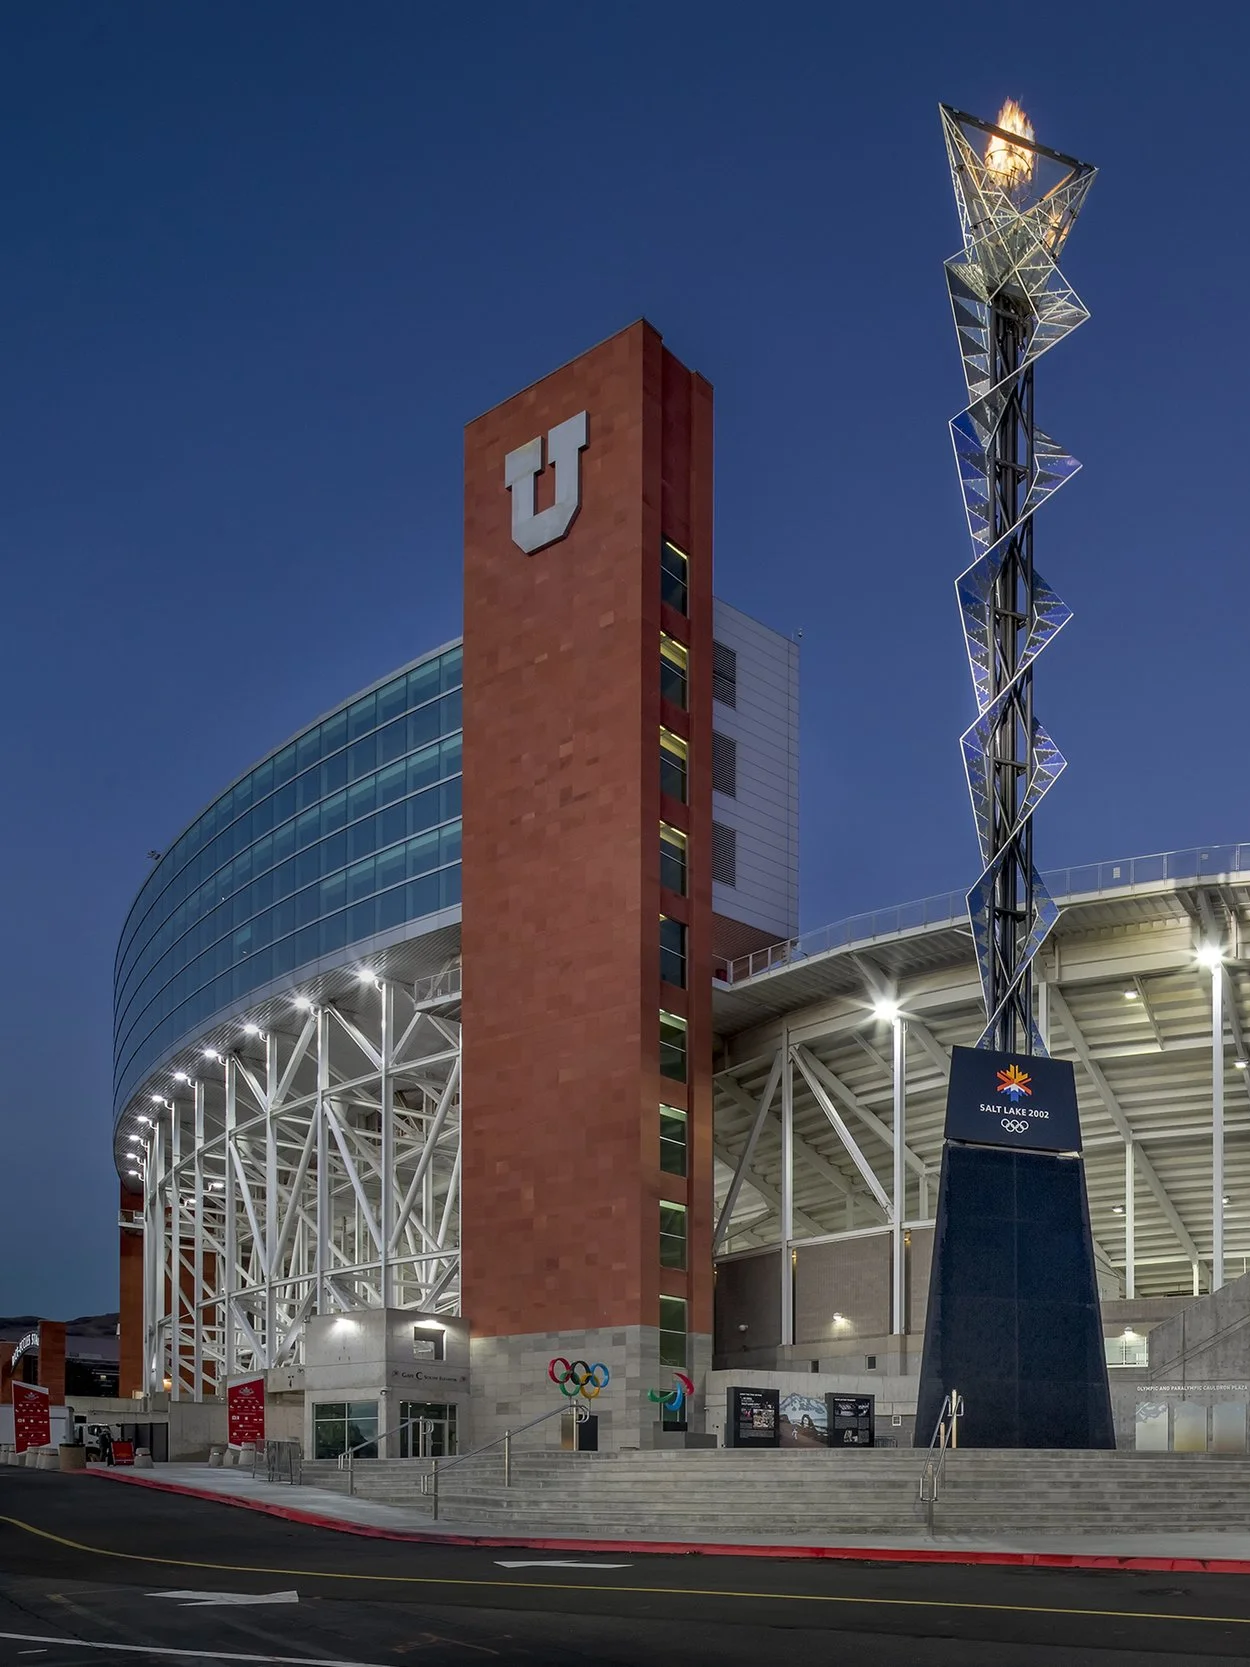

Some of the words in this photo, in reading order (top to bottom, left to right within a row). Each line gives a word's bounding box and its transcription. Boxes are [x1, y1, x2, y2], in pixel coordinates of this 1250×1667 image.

[505, 410, 590, 556] U
[979, 1103, 1002, 1114] SALT
[1003, 1106, 1027, 1117] LAKE
[1028, 1109, 1049, 1119] 2002
[416, 1371, 423, 1380] C
